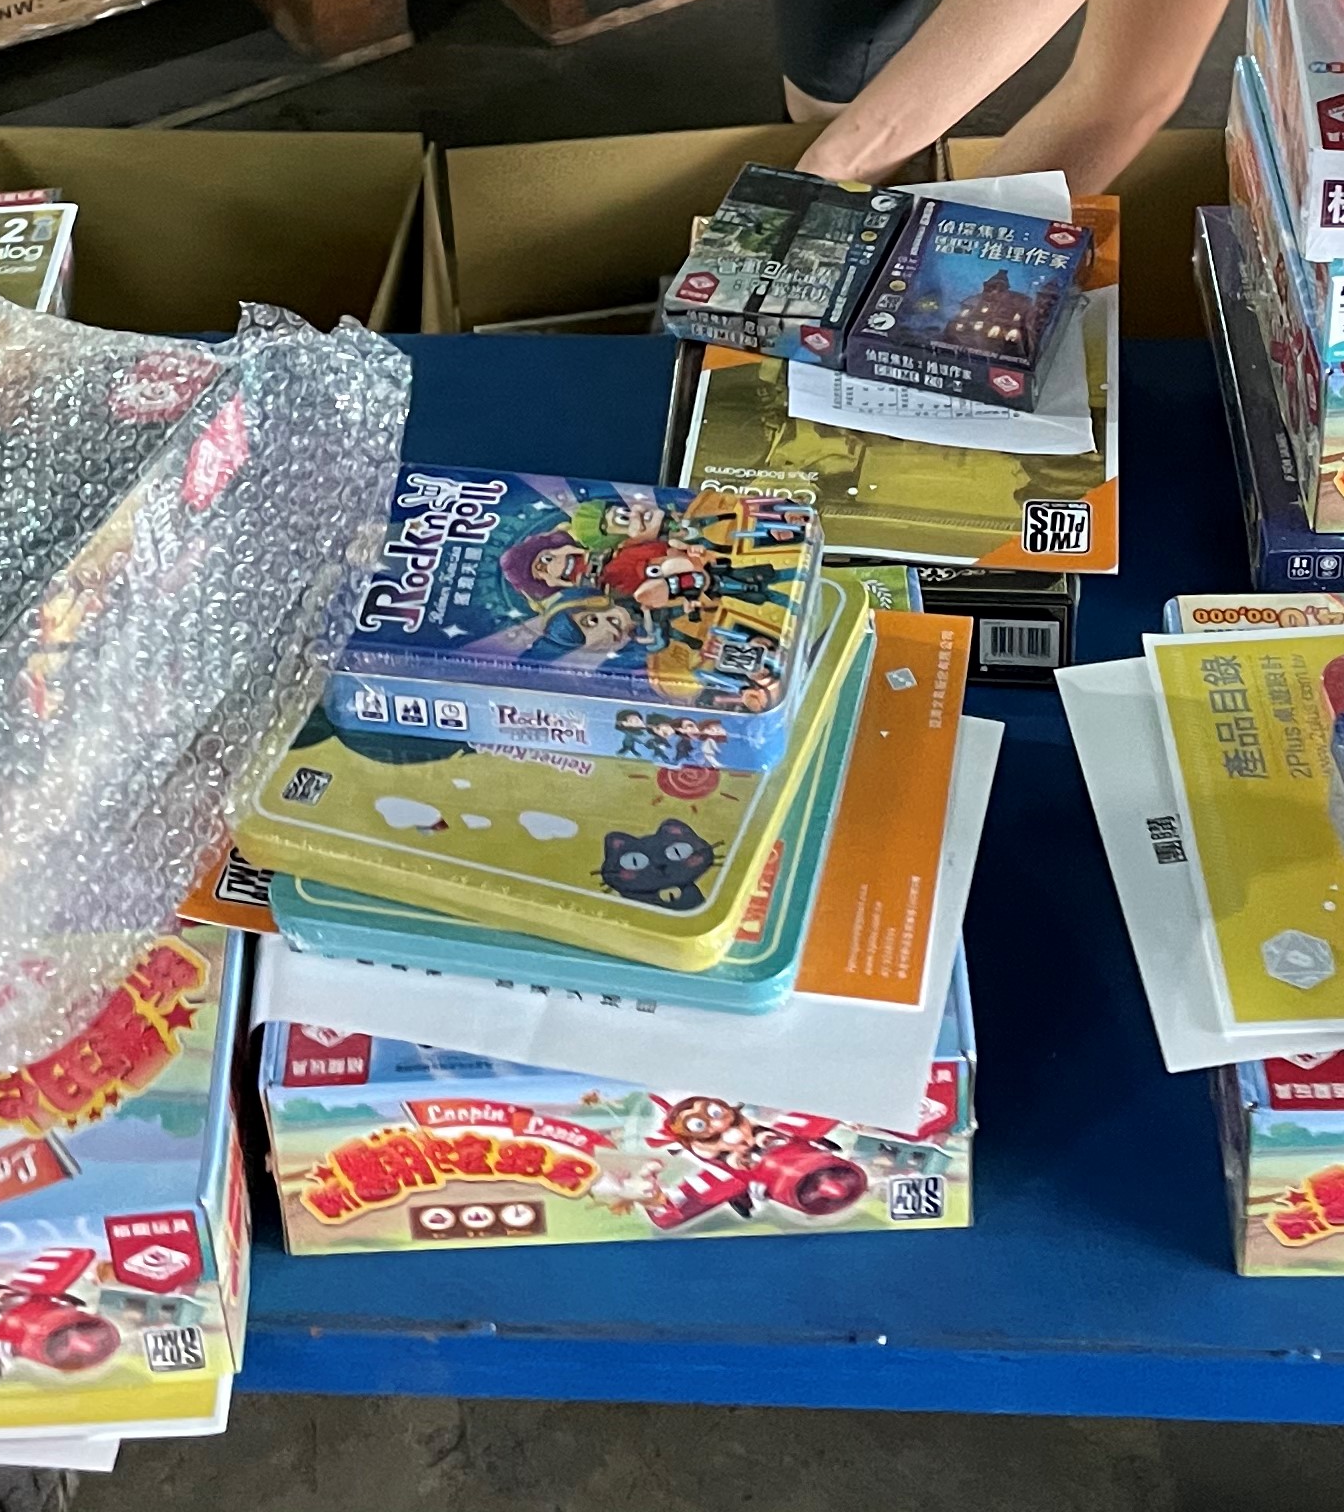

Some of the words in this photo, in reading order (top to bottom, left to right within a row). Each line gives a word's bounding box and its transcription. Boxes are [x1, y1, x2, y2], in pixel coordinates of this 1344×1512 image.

[980, 242, 1071, 270] 推理作家
[447, 481, 507, 544] Roll
[1027, 505, 1087, 537] PLUS
[1200, 654, 1270, 780] 產品目錄
[530, 750, 593, 775] Reiner
[1285, 725, 1314, 780] 2Plus
